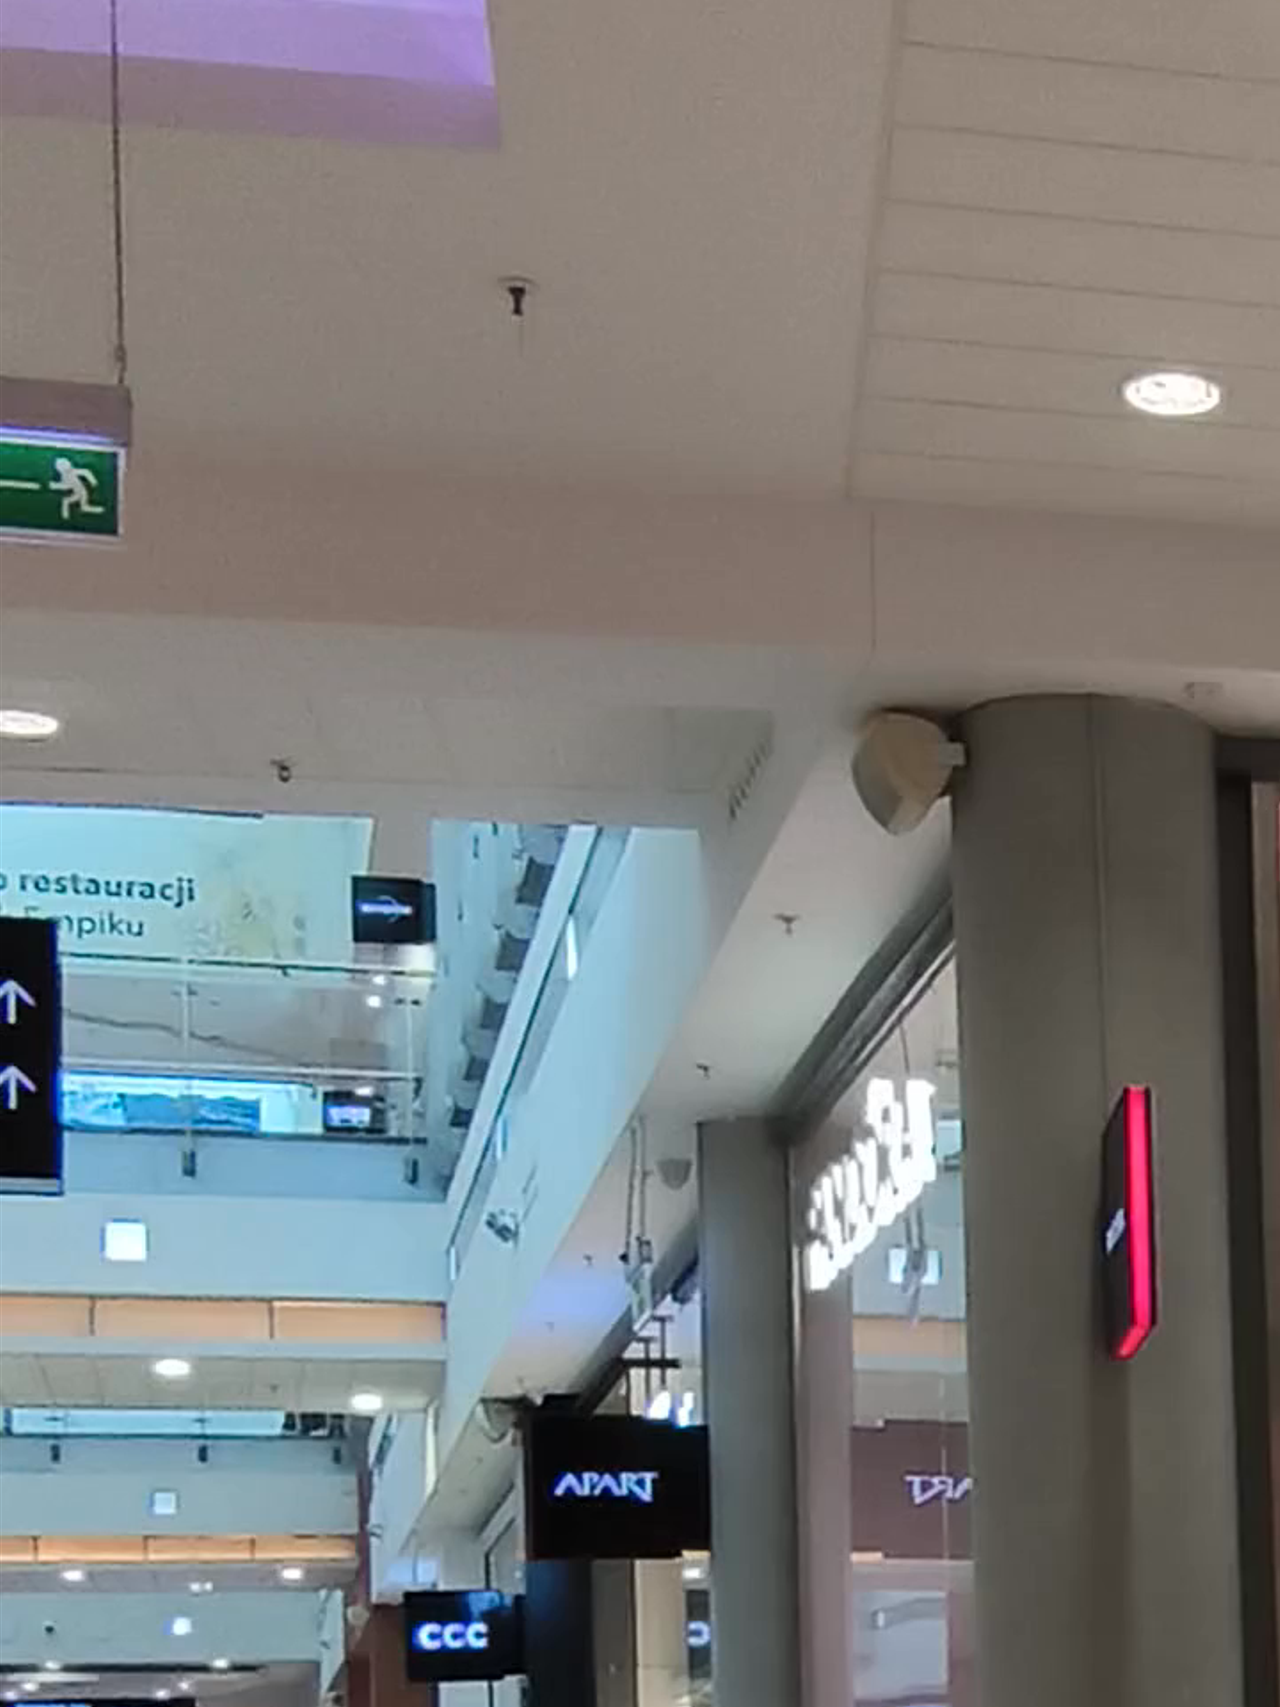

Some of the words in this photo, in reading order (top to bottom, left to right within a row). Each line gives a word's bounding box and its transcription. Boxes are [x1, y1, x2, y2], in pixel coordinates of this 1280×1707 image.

[19, 872, 196, 908] restauracji
[553, 1471, 659, 1503] APART
[418, 1622, 489, 1650] CCC
